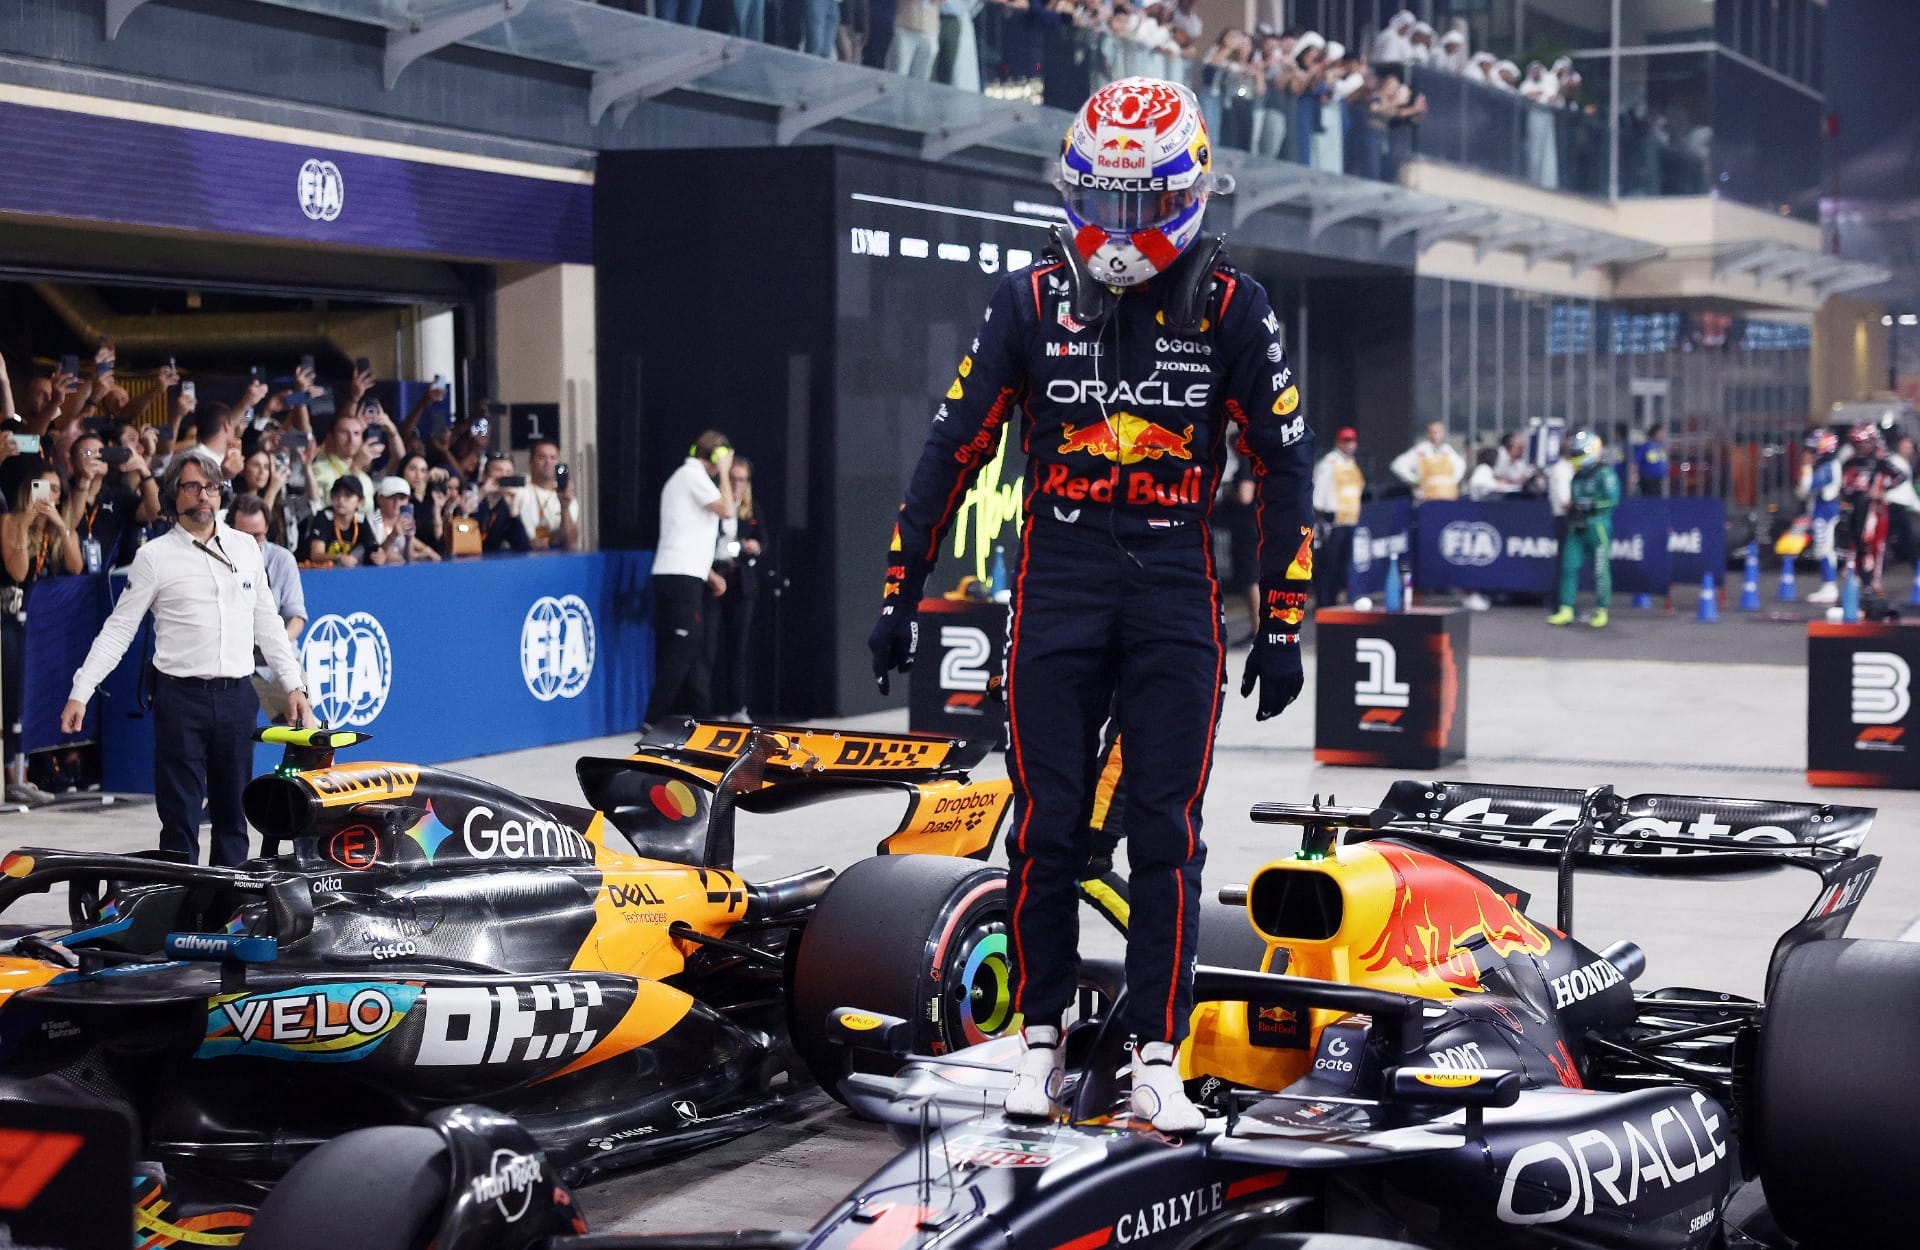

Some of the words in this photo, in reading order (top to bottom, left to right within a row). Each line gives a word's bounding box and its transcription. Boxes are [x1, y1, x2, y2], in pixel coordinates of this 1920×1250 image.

[1098, 156, 1120, 169] Red
[1121, 157, 1145, 169] Bull
[1080, 174, 1164, 192] ORACLE
[1104, 272, 1135, 284] Gate
[1046, 342, 1088, 357] Mobil
[1169, 339, 1212, 356] Gate
[1155, 361, 1212, 373] HONDA
[1046, 379, 1211, 408] ORACLE
[527, 413, 544, 440] 1
[1042, 463, 1120, 504] Red
[1126, 465, 1202, 506] Bull
[940, 626, 991, 691] 2
[1355, 638, 1410, 707] 1
[1851, 652, 1911, 724] 3
[934, 791, 999, 815] Dropbox
[920, 816, 963, 835] Dash
[343, 831, 366, 864] E
[313, 877, 343, 893] okta
[607, 883, 664, 908] DELL
[174, 935, 228, 954] allwyn
[1550, 959, 1625, 1010] HONDA
[222, 989, 393, 1042] VELO
[1258, 1021, 1277, 1033] Red
[1278, 1023, 1297, 1035] Bull
[1315, 1056, 1353, 1072] Gate
[1497, 1091, 1726, 1224] ORACLE
[1116, 1182, 1223, 1245] CARLYLE
